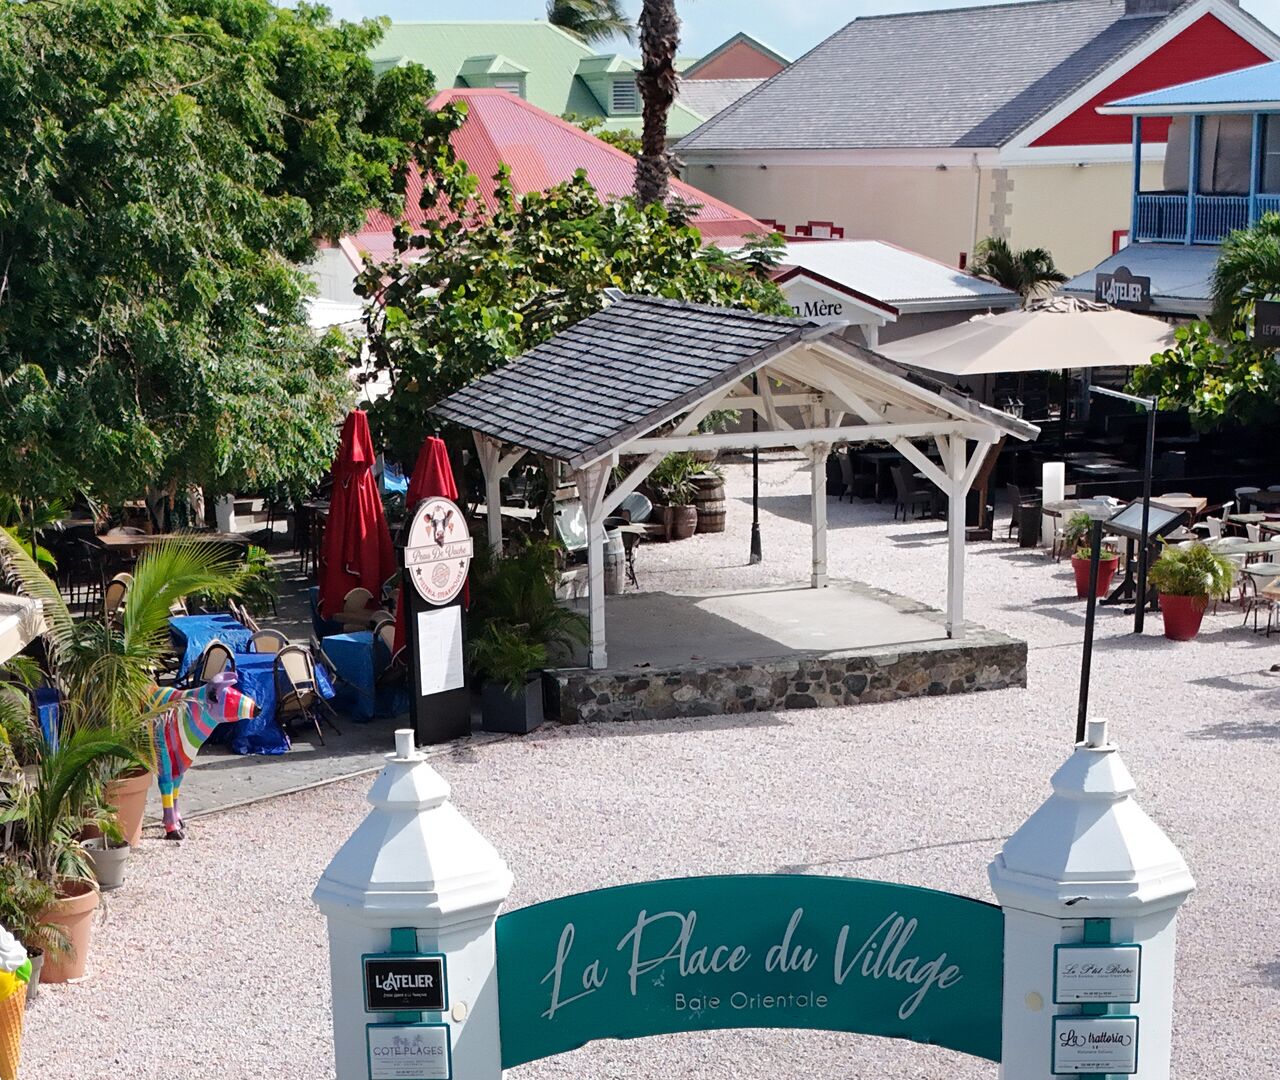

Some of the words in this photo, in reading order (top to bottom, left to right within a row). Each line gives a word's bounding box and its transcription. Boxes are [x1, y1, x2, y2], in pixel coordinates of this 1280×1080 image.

[804, 300, 842, 317] Mère
[540, 922, 608, 1020] La
[617, 908, 751, 996] Place
[765, 907, 818, 974] du
[833, 910, 963, 1021] Village
[675, 992, 721, 1011] Baie
[730, 991, 828, 1010] Orientale
[1060, 1029, 1086, 1047] La
[1088, 1031, 1132, 1047] trattoria
[404, 1046, 443, 1056] PLAGES
